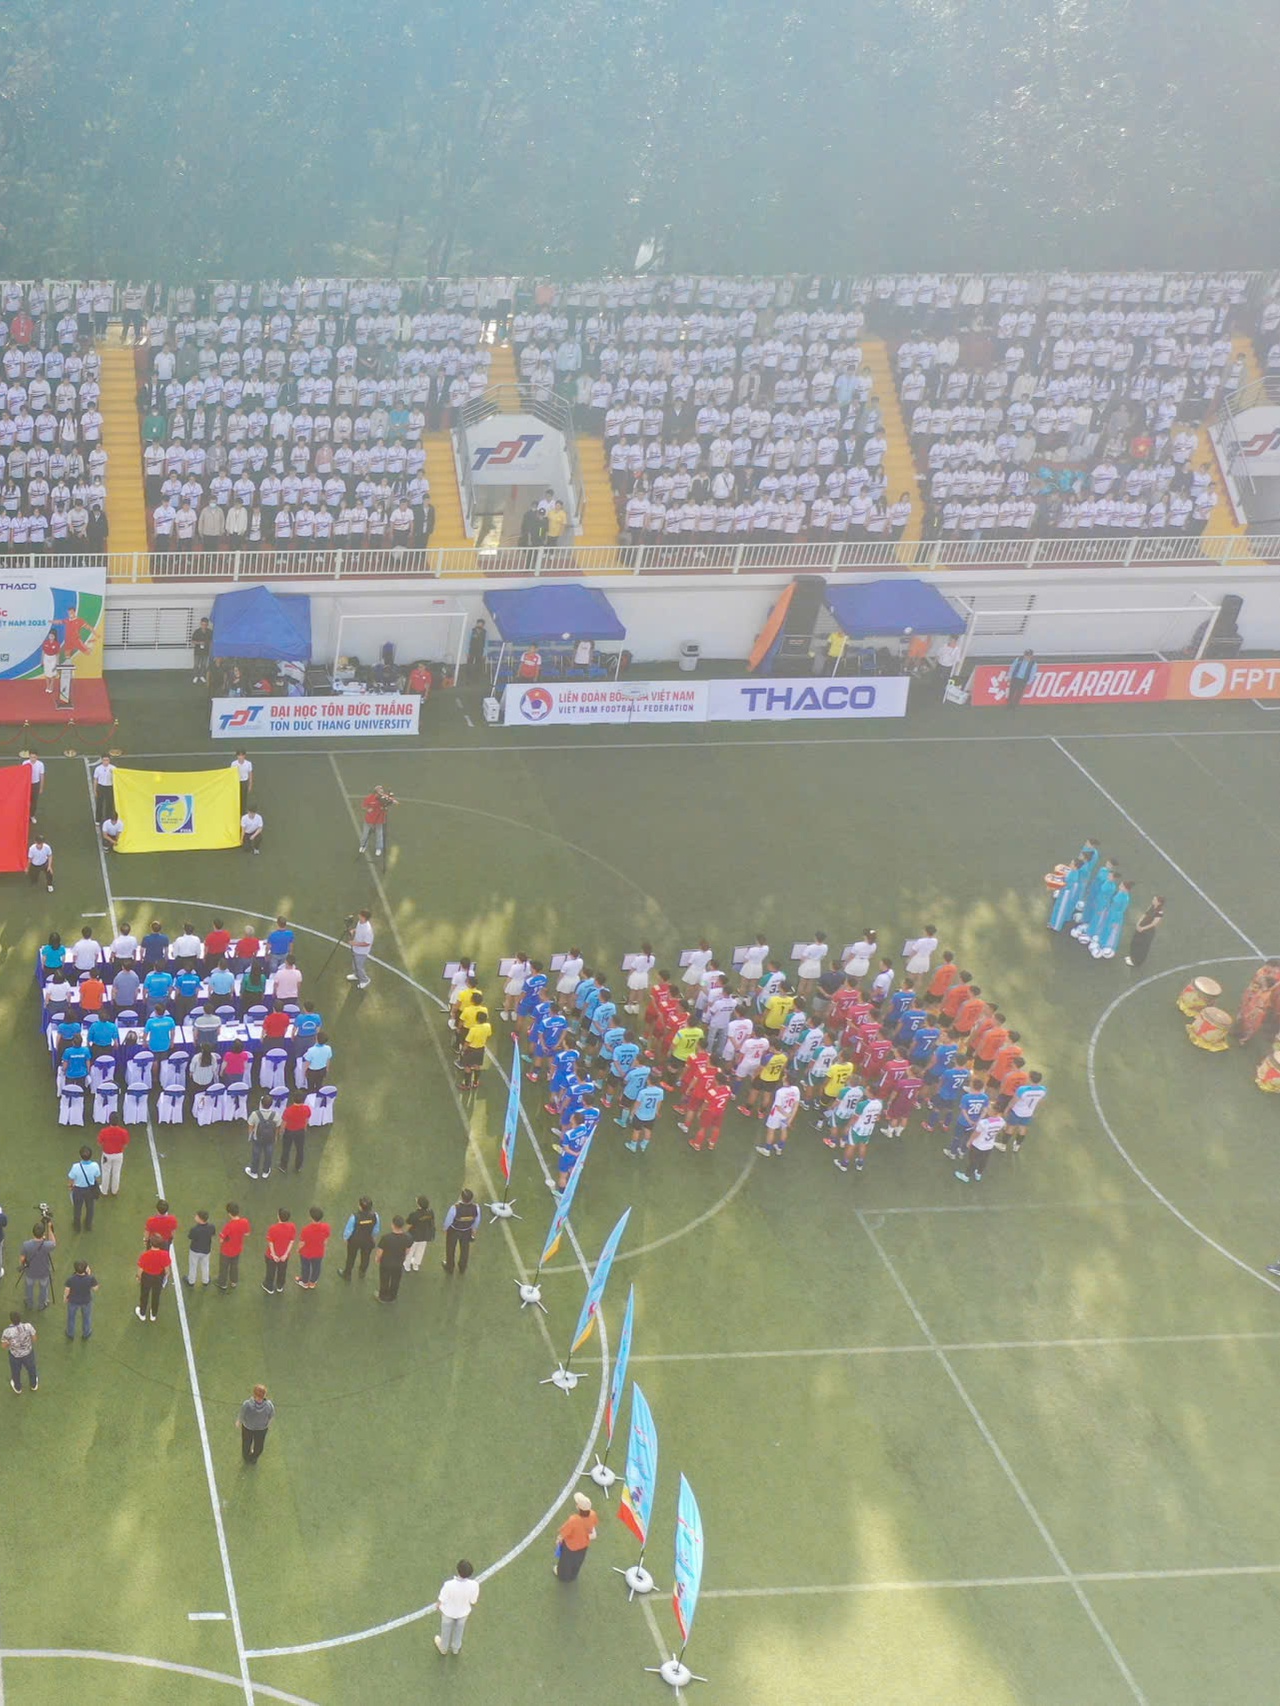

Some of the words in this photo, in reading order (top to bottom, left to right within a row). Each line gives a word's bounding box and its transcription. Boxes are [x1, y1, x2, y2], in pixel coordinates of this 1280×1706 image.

[0, 583, 37, 591] THACO
[651, 689, 672, 703] VIỆT
[673, 691, 695, 701] NAM
[740, 685, 876, 712] THACO
[270, 705, 290, 718] ĐẠI
[293, 705, 317, 719] HỌC
[321, 703, 344, 716] TÔN
[347, 702, 371, 716] ĐỨC
[558, 706, 576, 714] VIET
[579, 706, 598, 714] NAM
[600, 704, 640, 713] FOOTBALL
[643, 703, 694, 713] FEDERATION
[270, 719, 290, 731] TON
[293, 719, 313, 731] DUC
[317, 719, 351, 730] THANG
[355, 719, 412, 729] UNIVERSITY
[911, 1020, 920, 1031] 6
[551, 1027, 559, 1038] 7
[923, 1039, 932, 1051] 7
[620, 1054, 634, 1066] 22
[823, 1058, 830, 1068] 4
[566, 1062, 573, 1072] 2
[952, 1078, 965, 1089] 21
[646, 1098, 657, 1109] 21
[717, 1098, 726, 1109] 2
[968, 1104, 982, 1115] 28
